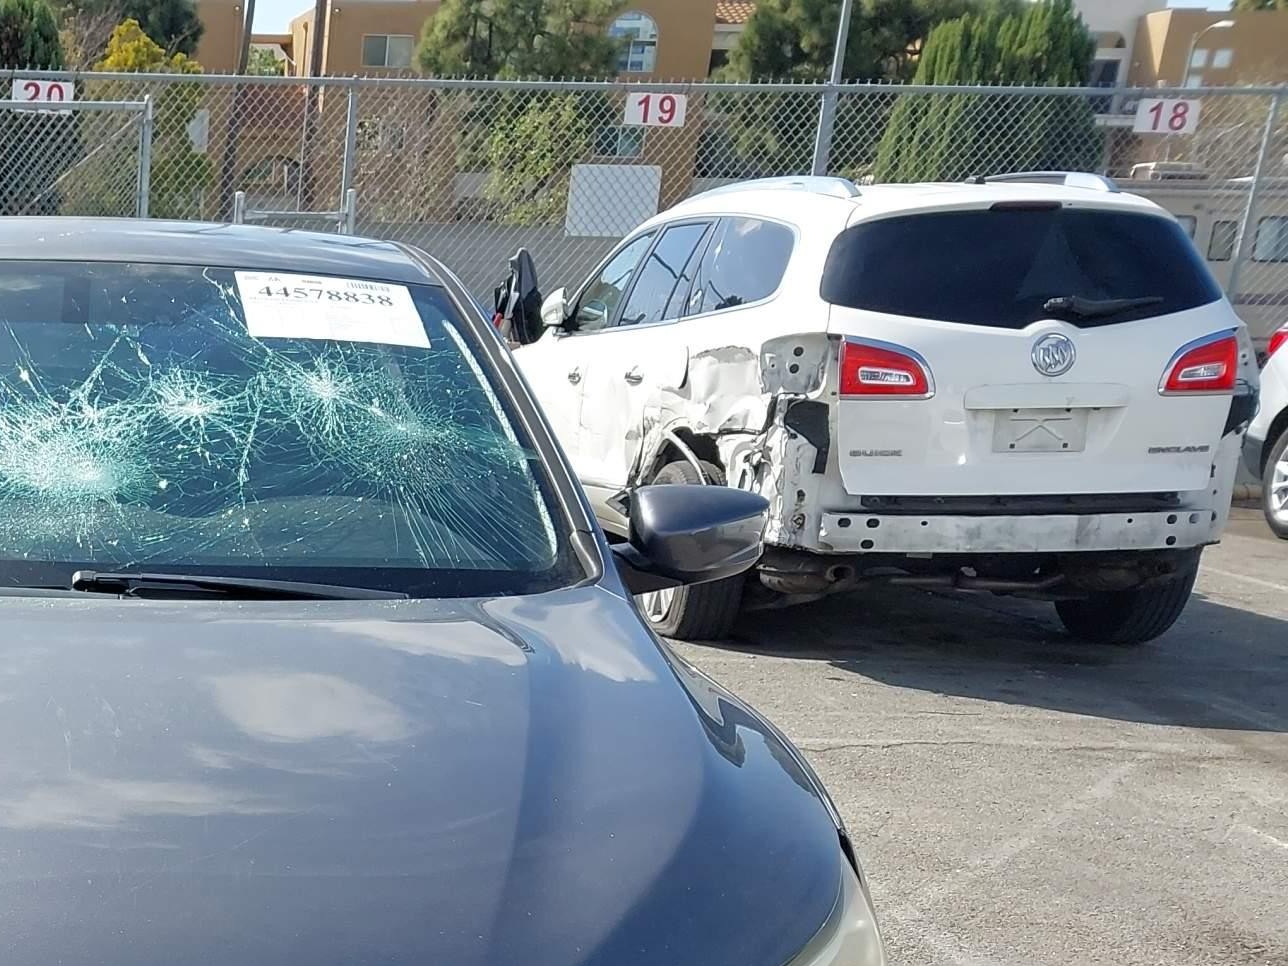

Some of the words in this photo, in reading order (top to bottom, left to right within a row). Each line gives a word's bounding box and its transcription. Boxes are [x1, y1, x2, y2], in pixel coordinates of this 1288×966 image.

[23, 82, 64, 108] 20
[638, 95, 676, 124] 19
[1149, 101, 1189, 131] 18
[258, 285, 394, 307] 44578838
